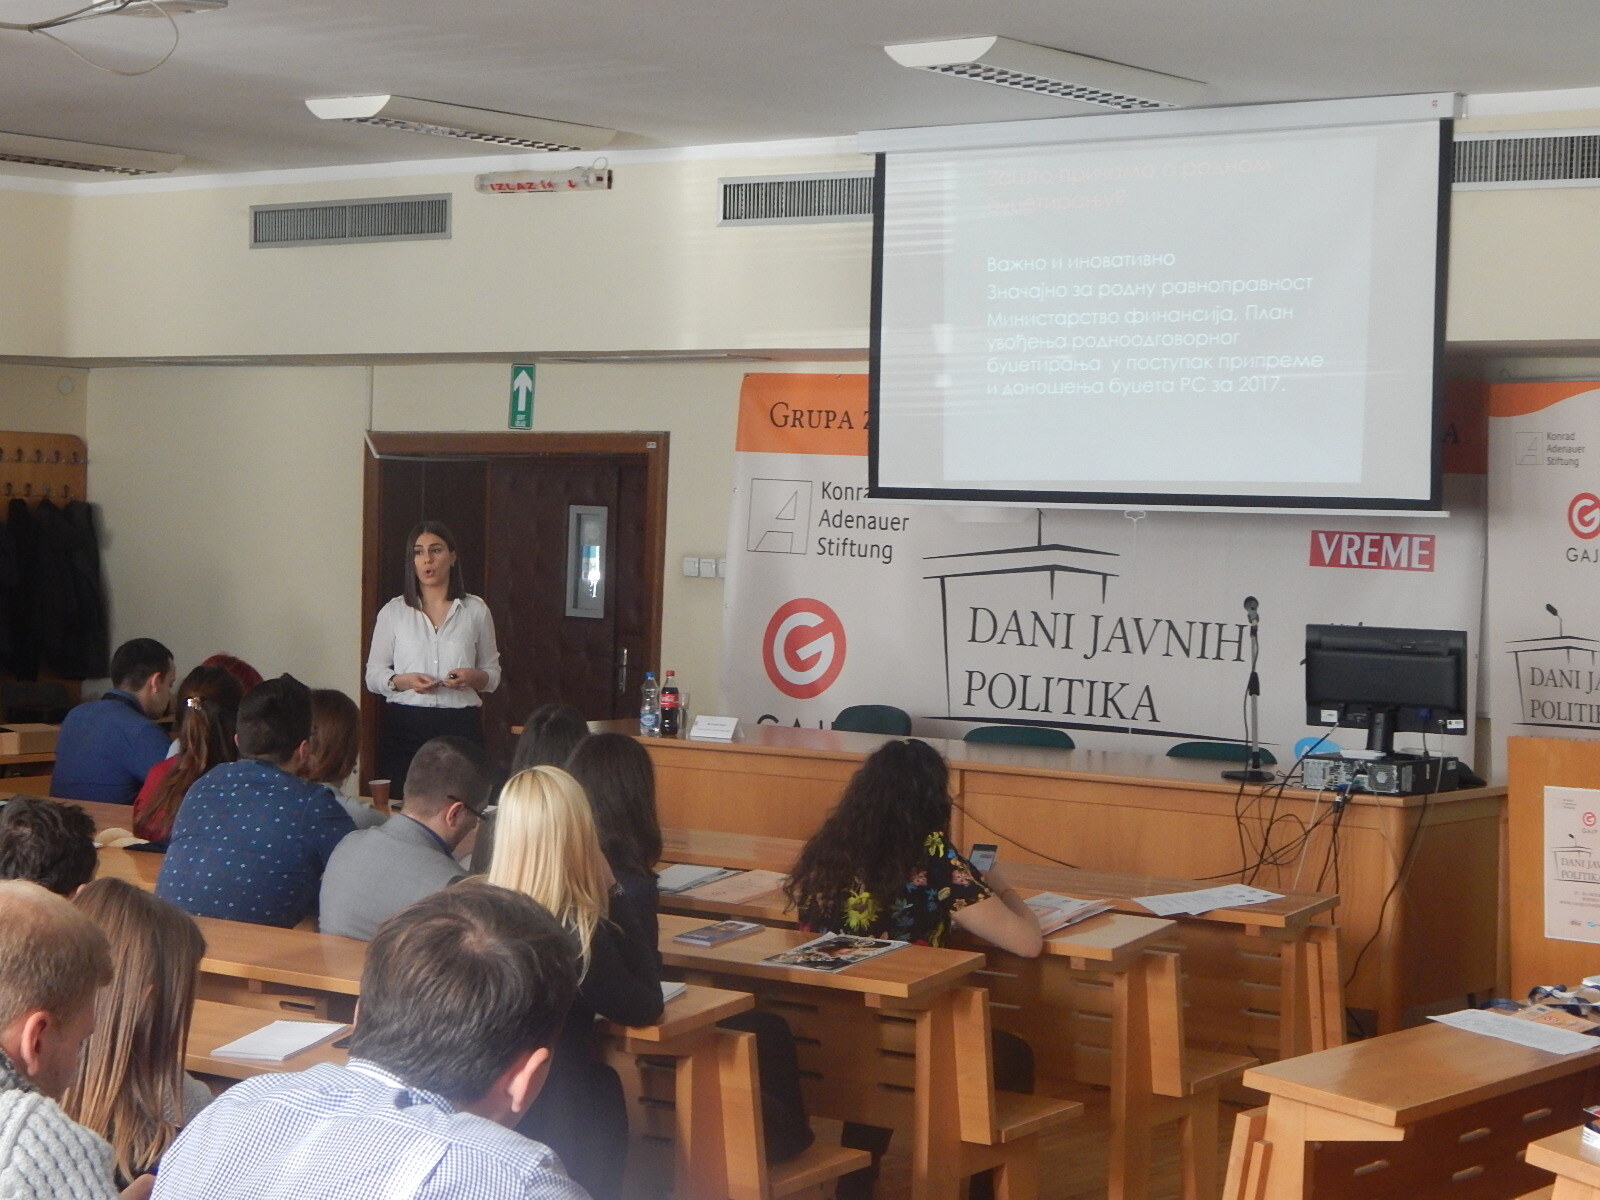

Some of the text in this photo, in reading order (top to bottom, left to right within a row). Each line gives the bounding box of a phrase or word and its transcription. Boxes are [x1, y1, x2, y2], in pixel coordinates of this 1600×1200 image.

[987, 253, 1176, 272] Важно и иновативно
[987, 277, 1314, 302] Значајно за родну равноправност
[987, 304, 1294, 329] Министарство финансија, План
[986, 330, 1241, 353] увођења родноодговорног
[986, 353, 1325, 376] буџетирања у поступак припреме
[987, 376, 1286, 396] и доношења буџета РС за 2017.
[769, 401, 855, 430] GRUPA
[1546, 431, 1576, 441] Konrad
[1546, 444, 1586, 454] Adenauer
[1546, 456, 1580, 468] Stiftung
[818, 509, 910, 532] Adenauer
[816, 536, 893, 565] Stiftung
[1317, 533, 1431, 570] VREME
[967, 606, 1249, 664] DANI JAVNIH
[1530, 667, 1581, 690] DANI
[963, 669, 1163, 724] POLITIKA
[1561, 857, 1585, 869] DANI
